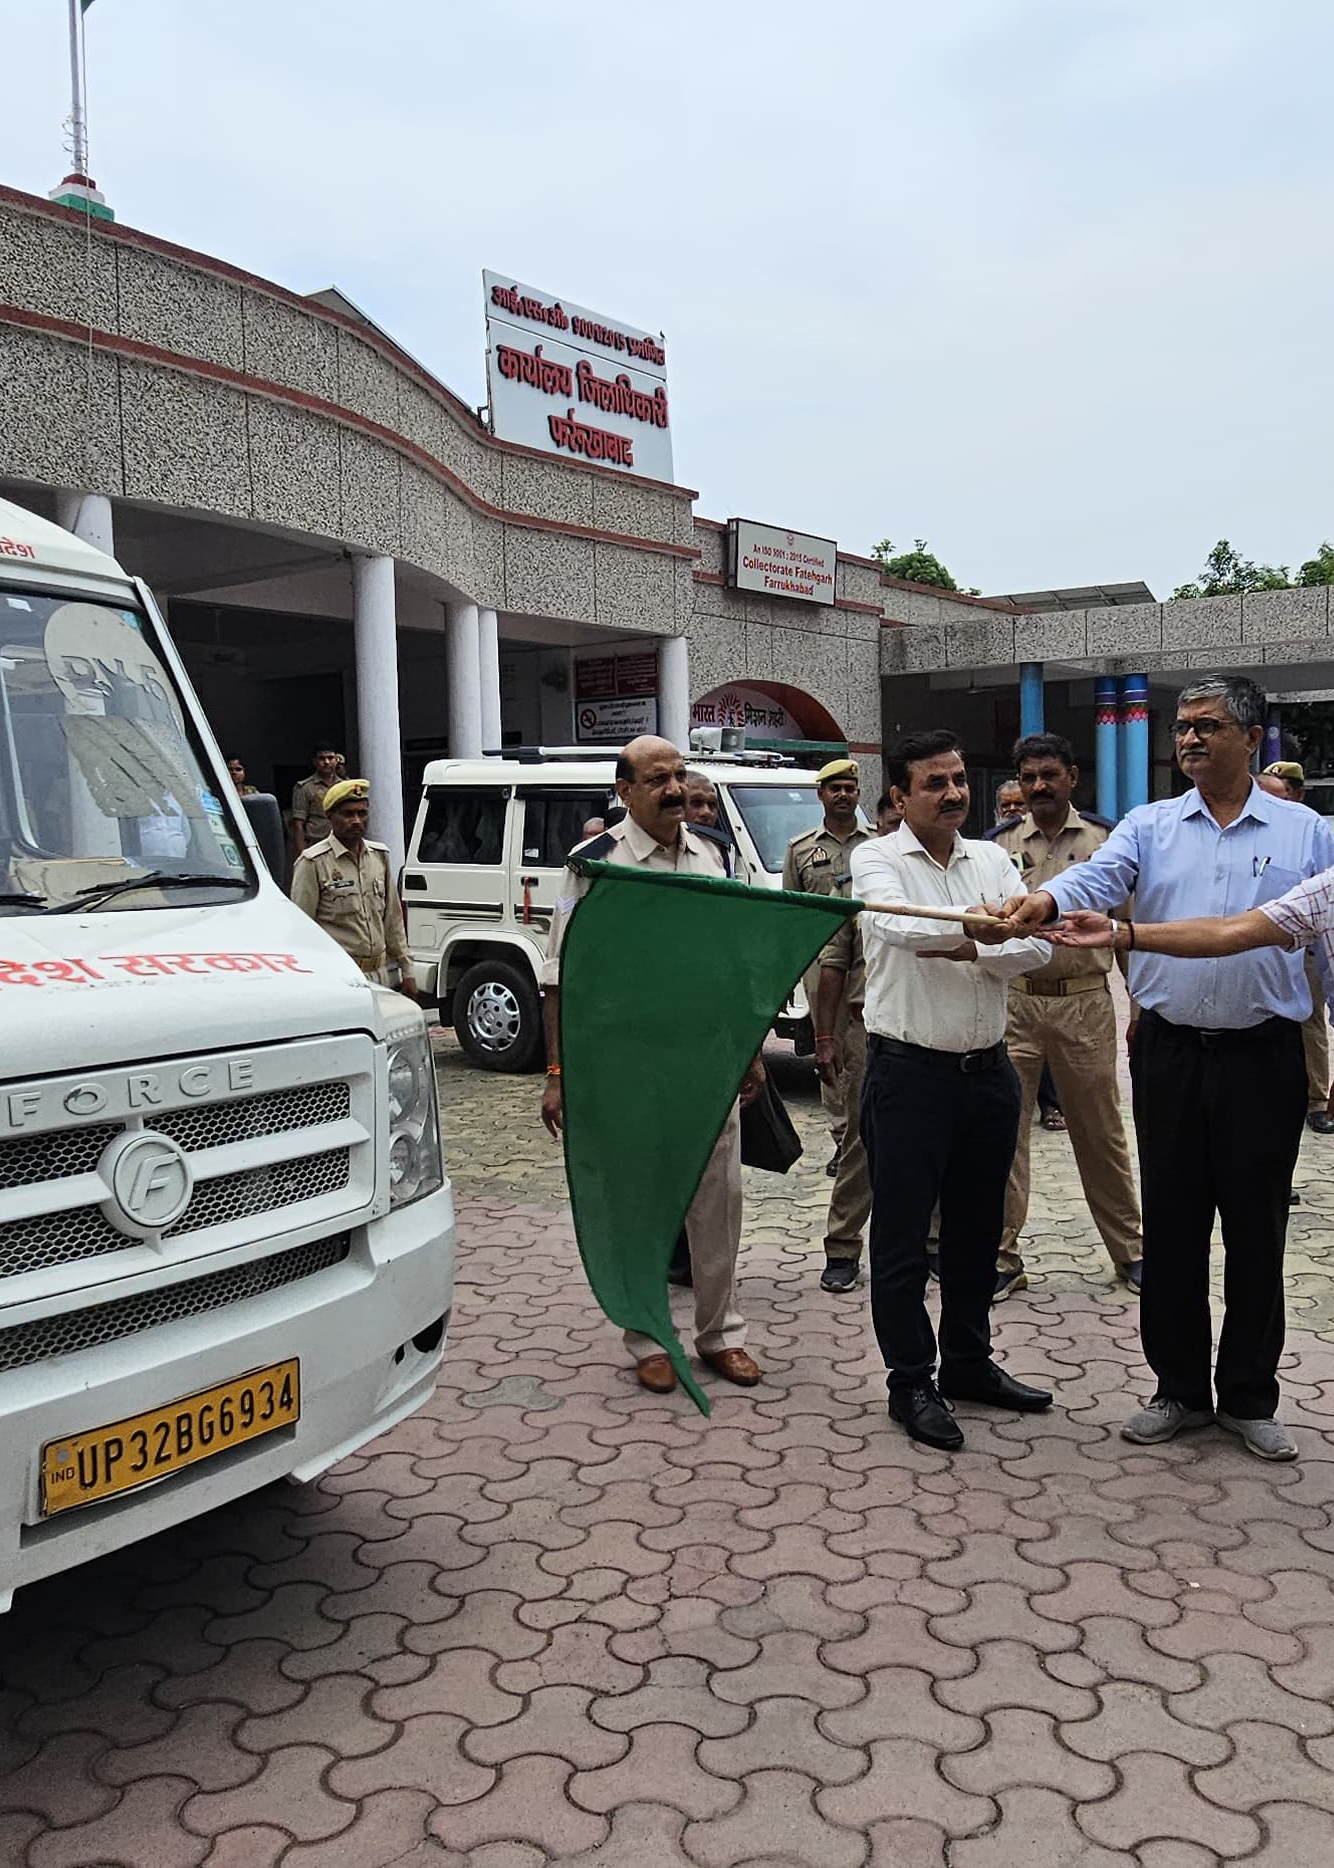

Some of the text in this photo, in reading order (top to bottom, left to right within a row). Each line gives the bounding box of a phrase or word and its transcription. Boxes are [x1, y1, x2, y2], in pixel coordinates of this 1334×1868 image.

[496, 344, 669, 428] कार्यालय जिलाधिकारी
[743, 555, 833, 585] Collectorate Fatehgarh
[764, 575, 814, 596] Farrukhabad
[692, 704, 715, 722] भारत
[744, 702, 766, 727] मिशन
[98, 952, 313, 975] सरकार
[8, 1058, 255, 1127] FORCE
[50, 1372, 294, 1490] IND UP32BG6934
